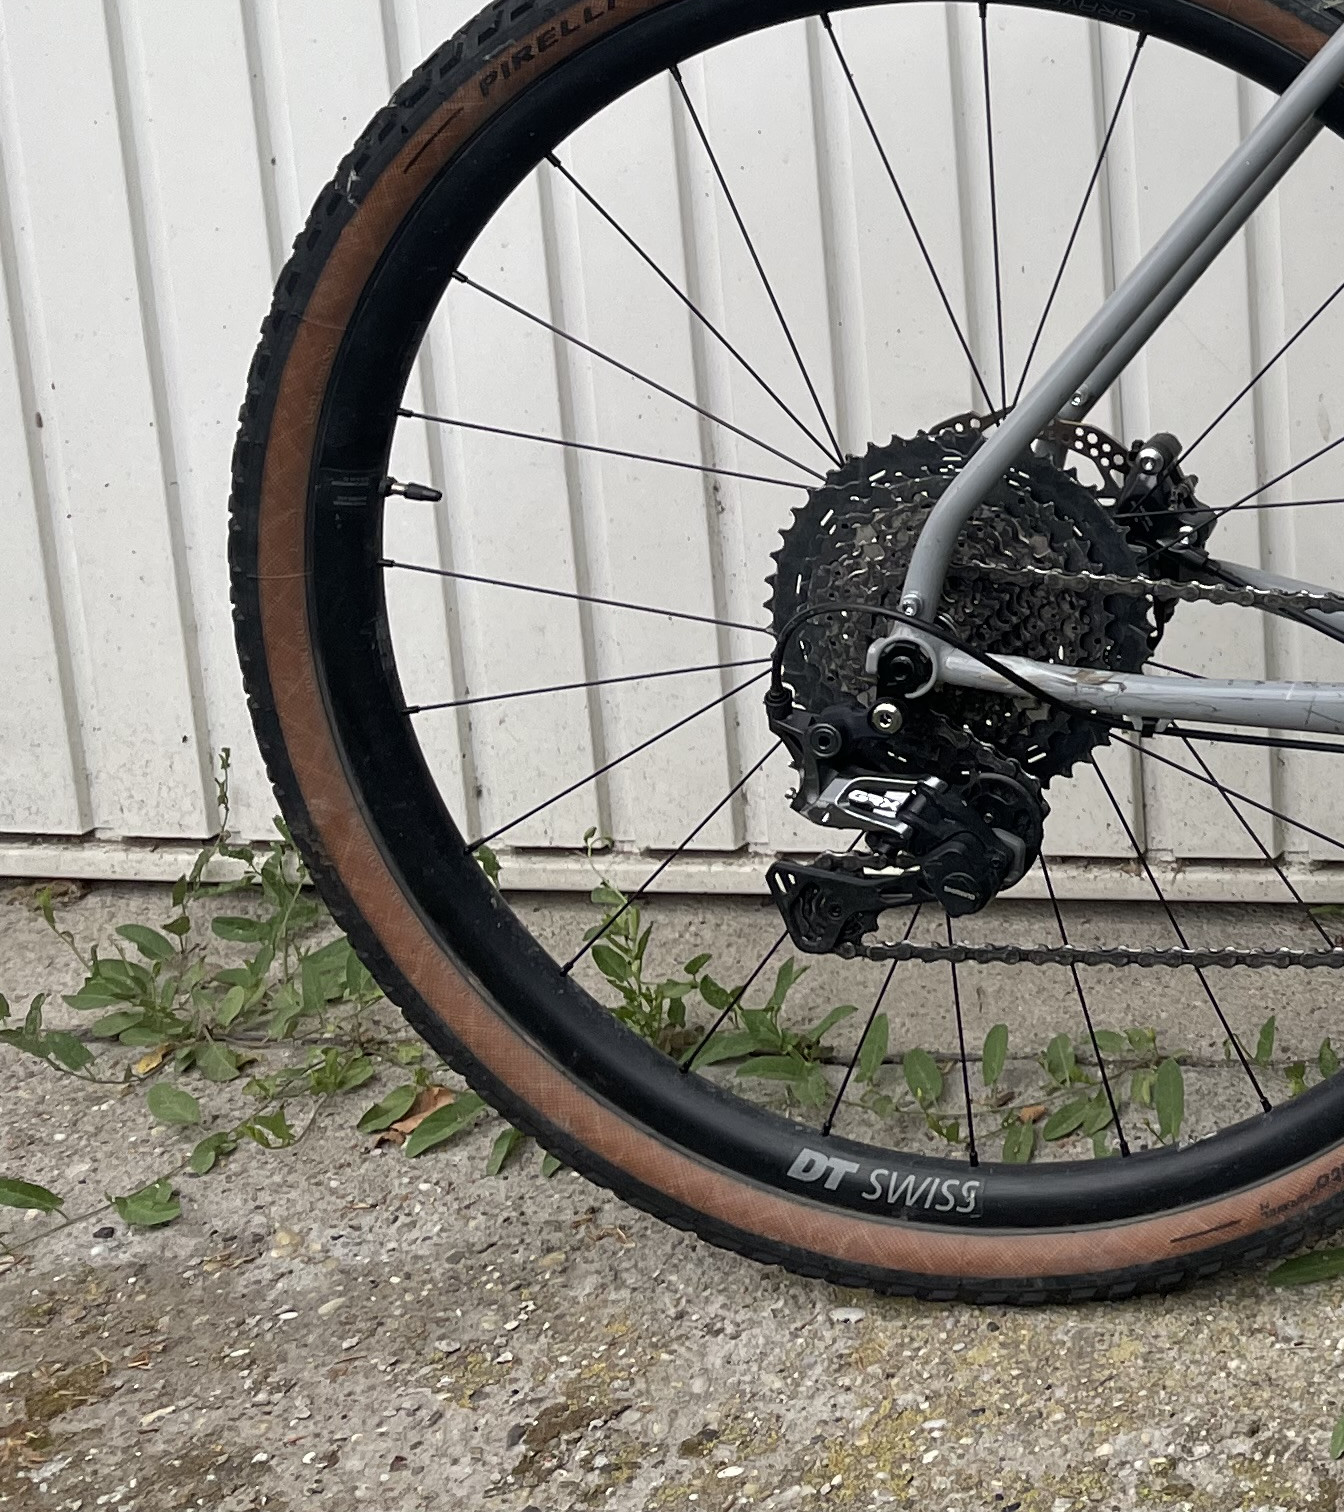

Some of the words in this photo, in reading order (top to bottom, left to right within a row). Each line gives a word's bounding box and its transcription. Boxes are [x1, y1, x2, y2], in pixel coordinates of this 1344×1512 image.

[847, 789, 904, 812] GRX
[787, 1147, 860, 1191] DT
[861, 1168, 981, 1214] SWISS
